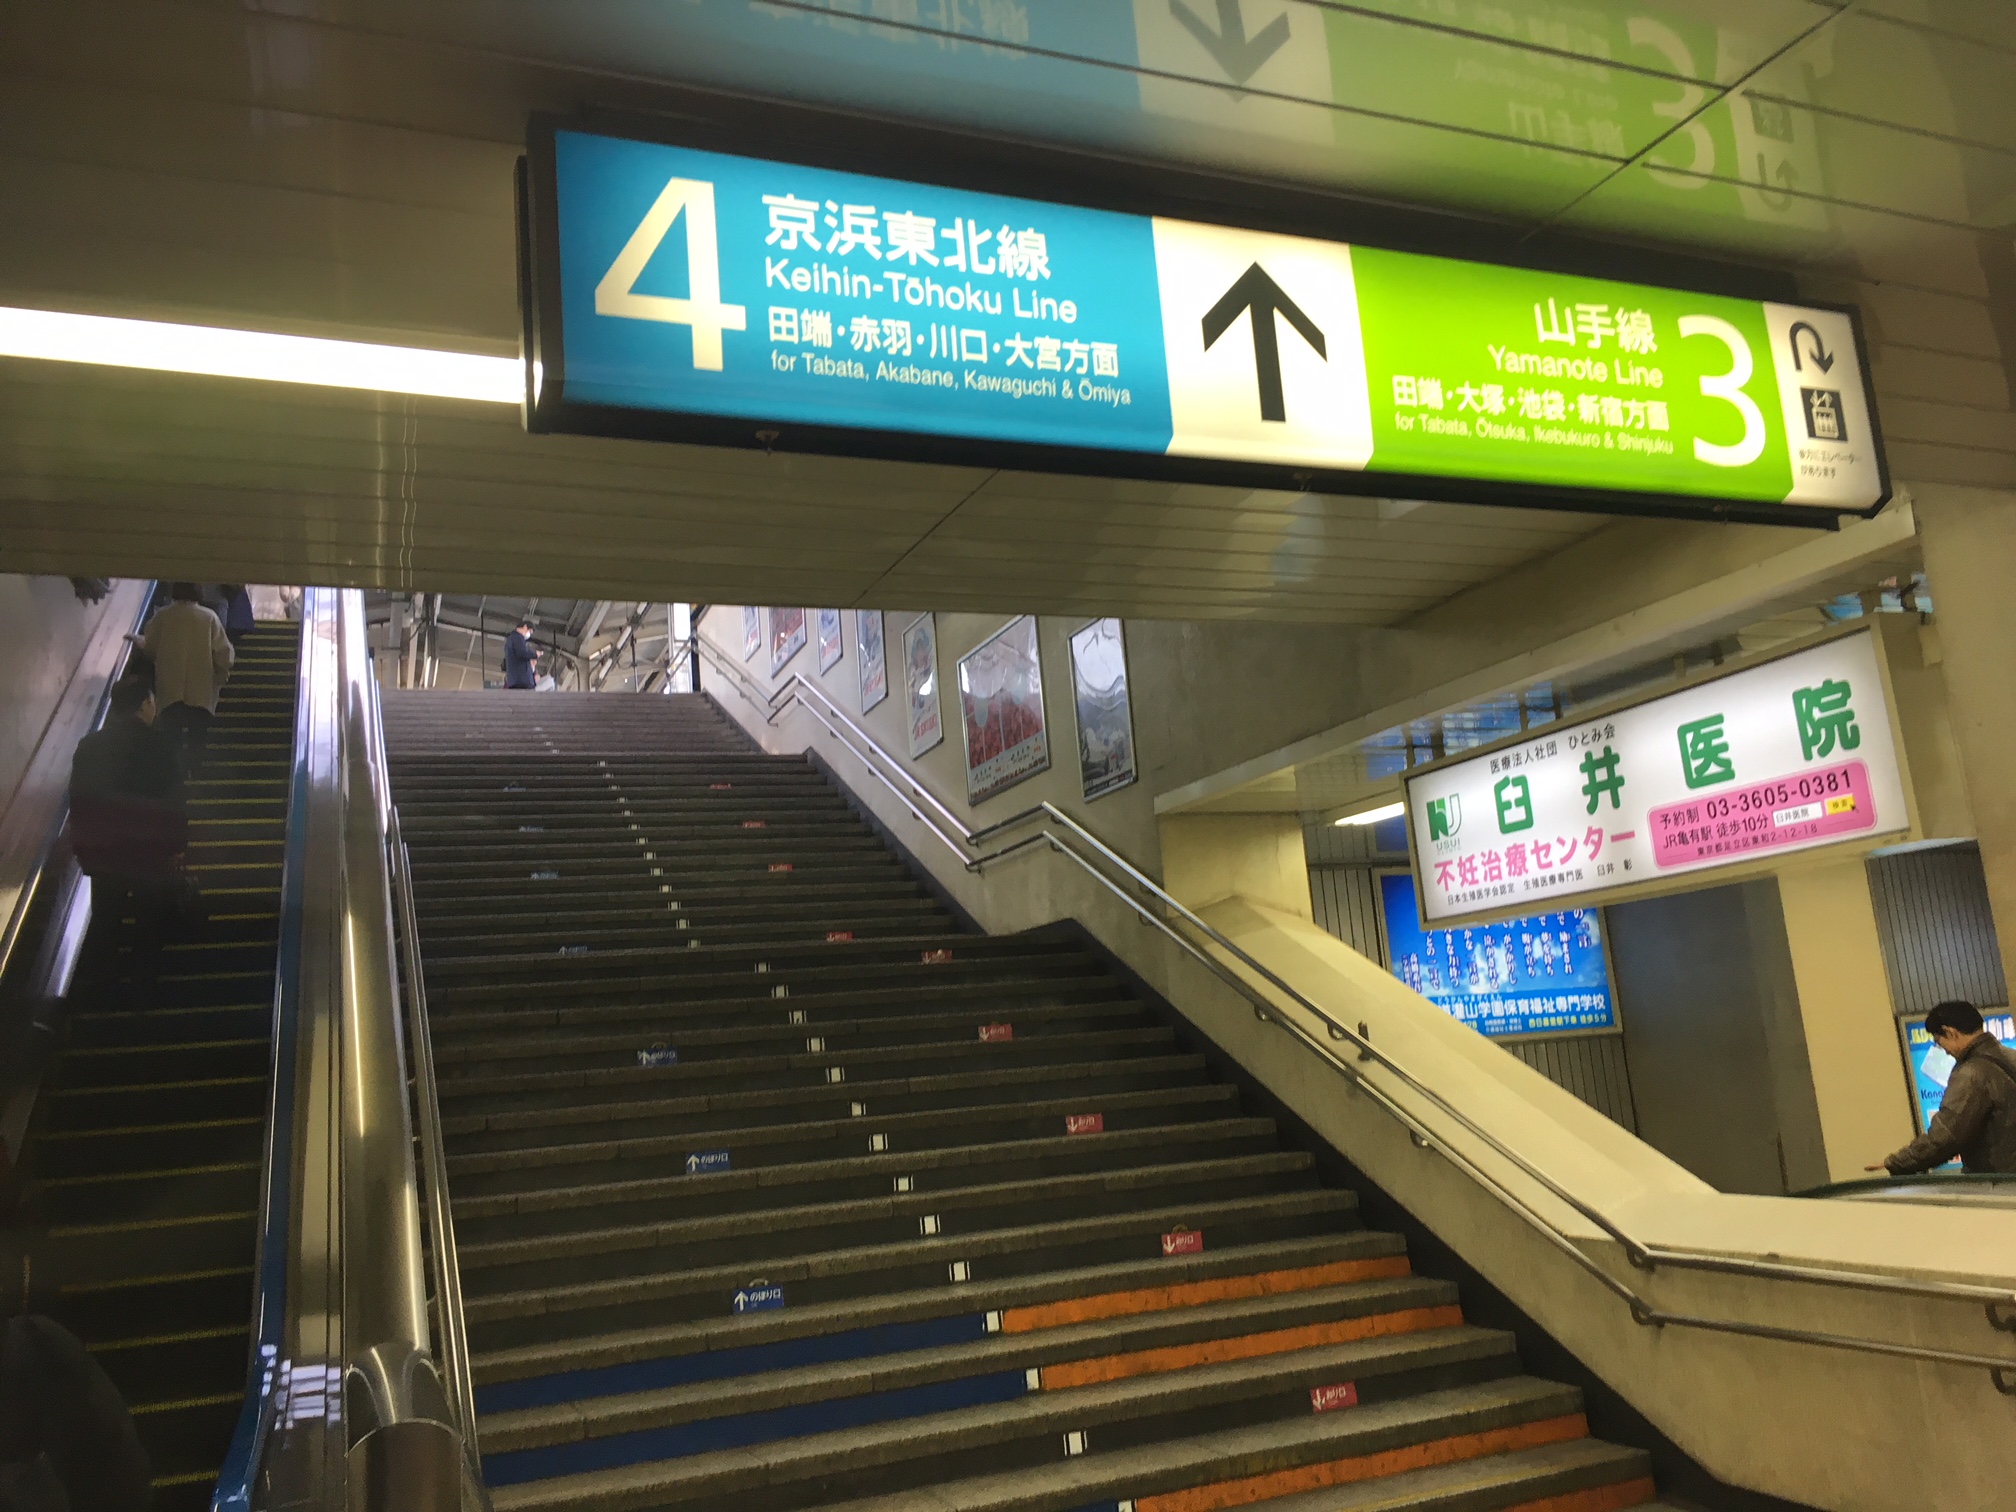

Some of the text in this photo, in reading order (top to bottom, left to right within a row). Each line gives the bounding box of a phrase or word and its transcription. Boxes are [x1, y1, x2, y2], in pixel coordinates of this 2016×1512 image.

[762, 192, 1051, 282] 京浜東北線
[595, 176, 746, 372] 4
[1013, 288, 1077, 323] Line
[1534, 297, 1658, 355] 山手線
[771, 349, 796, 371] for
[804, 352, 870, 382] Tabata,
[876, 361, 959, 391] Akabane,
[964, 369, 1057, 399] Kawaguchi
[1061, 381, 1075, 398] &
[1487, 343, 1663, 389] Yamanote Line
[1677, 314, 1766, 467] 3
[1395, 413, 1414, 431] for
[1420, 415, 1472, 438] Tabata,
[1534, 424, 1601, 449] Ikebukuro
[1617, 432, 1674, 456] Shinjuku
[1490, 722, 1616, 774] 医療法人社団 ひとみ会
[1660, 768, 1852, 830] 予約制 03-3605-0381
[1436, 837, 1461, 851] USUI
[1716, 814, 1768, 839] 徒歩10分
[1434, 826, 1636, 892] 不妊治療センター
